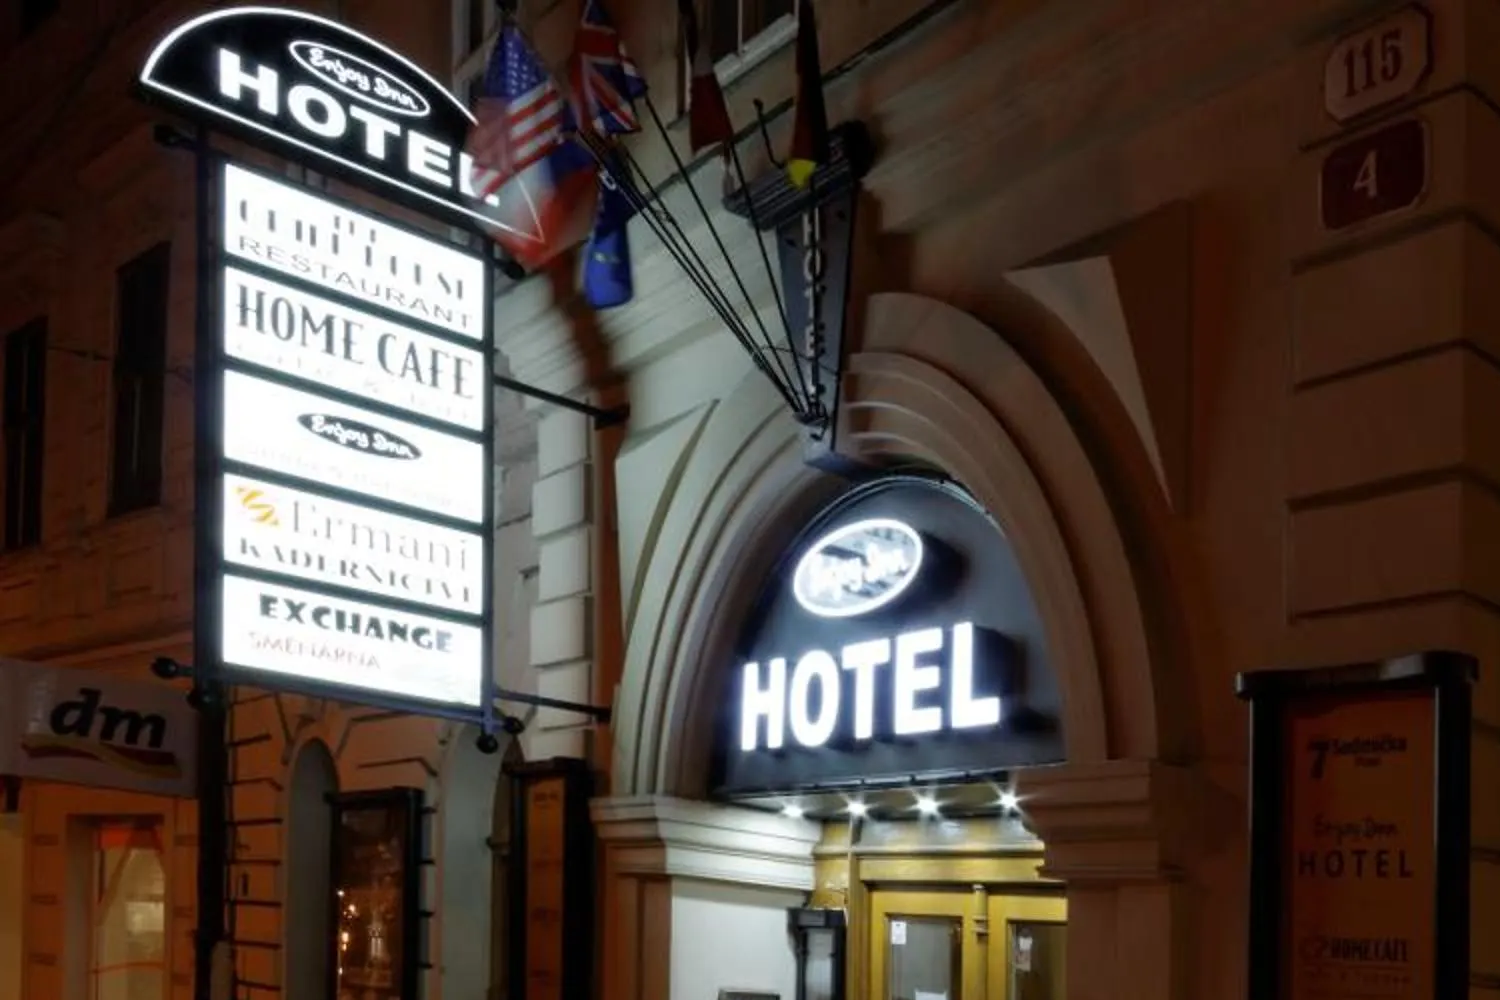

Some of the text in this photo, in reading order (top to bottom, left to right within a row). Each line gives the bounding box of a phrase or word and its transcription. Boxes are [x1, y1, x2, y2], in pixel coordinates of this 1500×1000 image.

[309, 47, 418, 110] Enjoy Inn
[1344, 28, 1403, 97] 115
[1353, 151, 1378, 198] 4
[238, 235, 472, 329] RESTAURANT
[237, 283, 364, 365] HOME
[376, 332, 475, 400] CAFE
[311, 415, 369, 449] Enjoy
[258, 592, 454, 654] EXCHANGE
[741, 621, 1000, 751] HOTEL
[50, 688, 167, 748] dm
[1298, 849, 1415, 879] HOTEL
